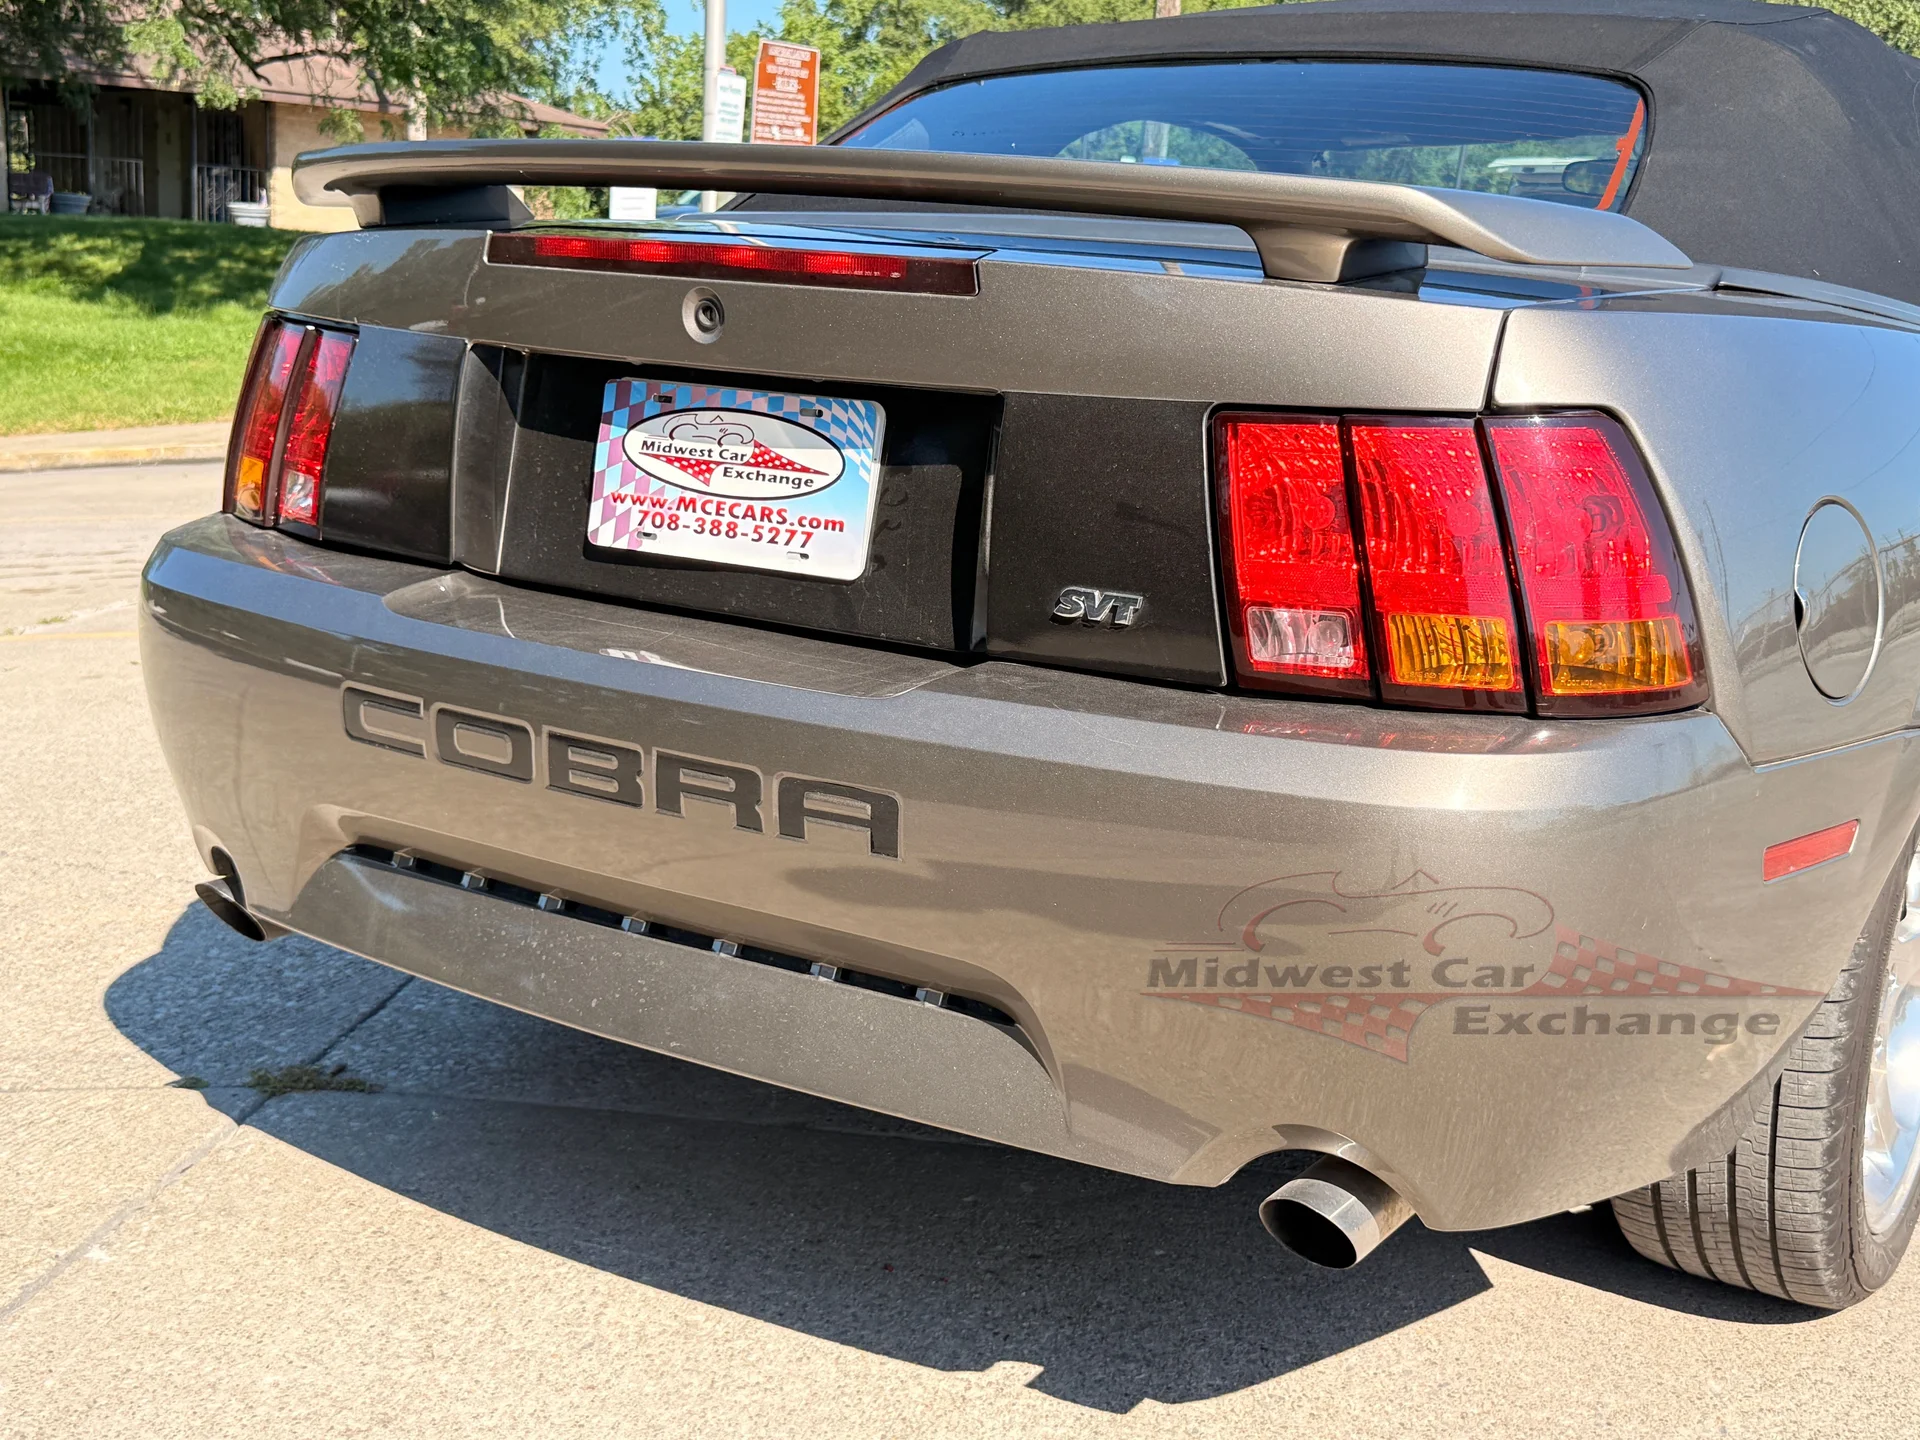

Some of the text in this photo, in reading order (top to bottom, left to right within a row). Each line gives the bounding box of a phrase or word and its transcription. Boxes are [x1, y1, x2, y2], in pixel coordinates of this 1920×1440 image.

[641, 440, 748, 463] Midwest Car
[723, 467, 814, 488] Exchange
[611, 492, 844, 532] www.MCECARS.com
[636, 510, 815, 549] 708-388-5277
[1053, 586, 1144, 626] SVT
[341, 682, 903, 861] COBRA
